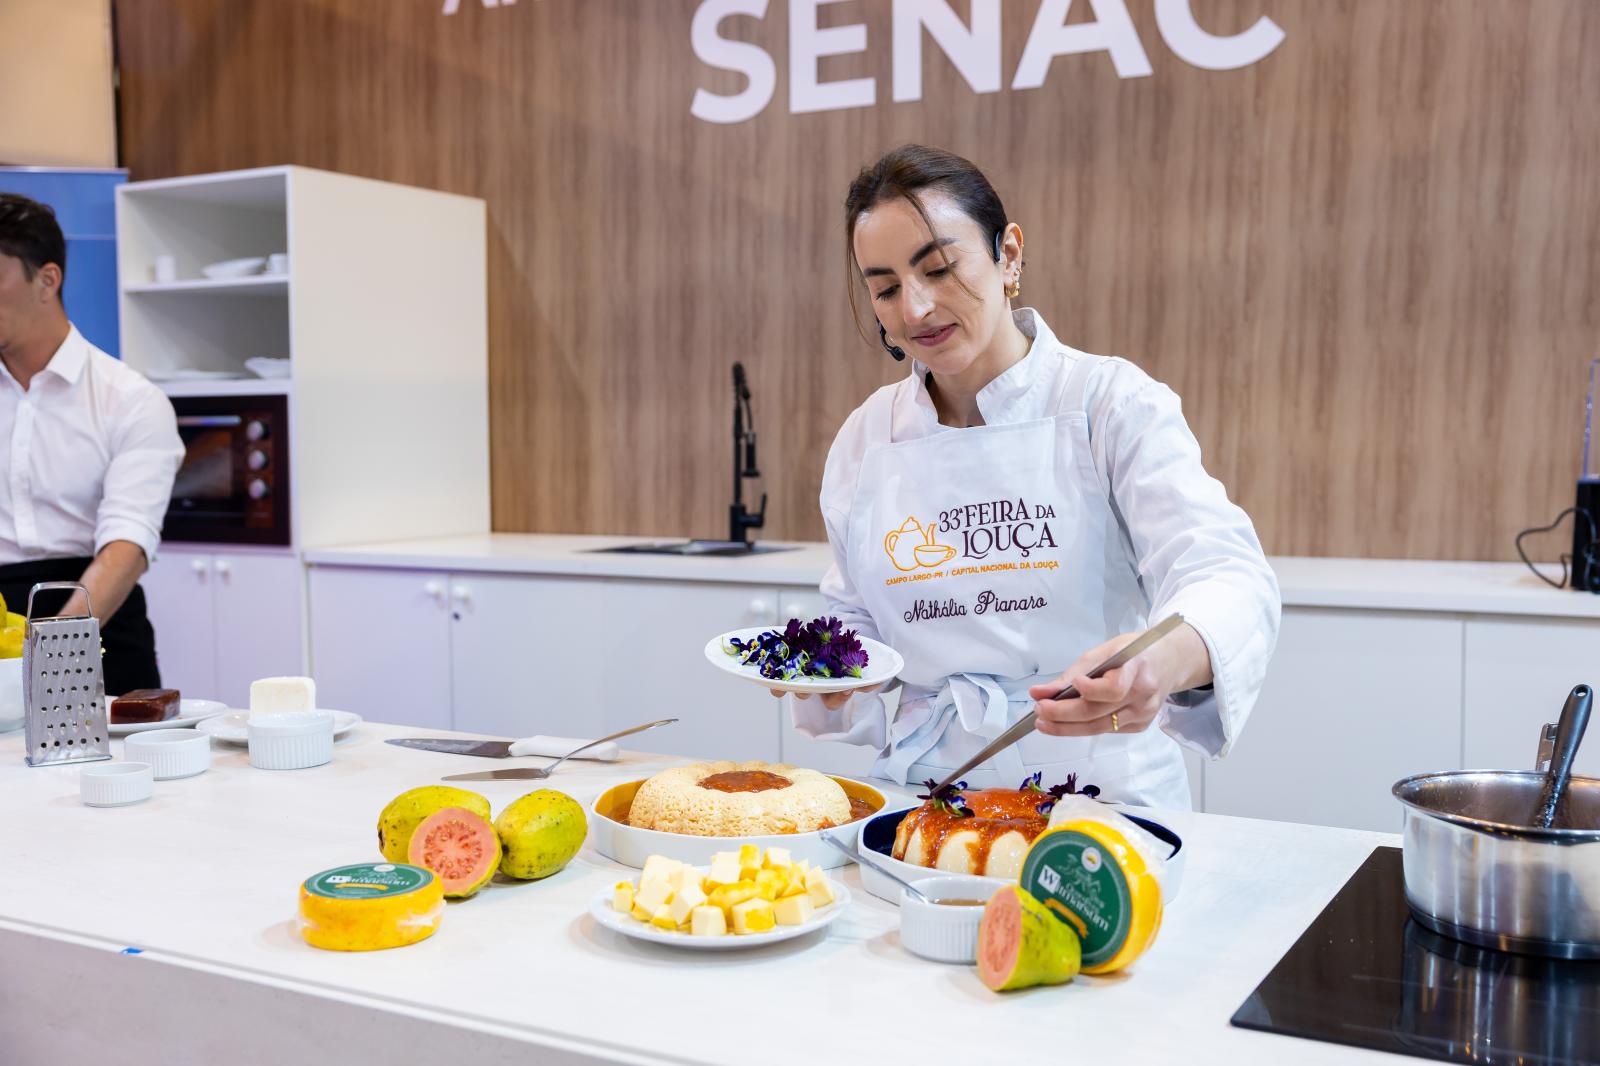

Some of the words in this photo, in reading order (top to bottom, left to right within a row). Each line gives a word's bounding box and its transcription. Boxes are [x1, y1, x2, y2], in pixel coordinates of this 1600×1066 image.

[1035, 504, 1056, 519] DA
[962, 521, 1058, 559] LOUÇA
[886, 575, 908, 586] CAMPO
[909, 571, 944, 582] LARGO-PR
[951, 567, 979, 577] CAPITAL
[980, 563, 1017, 573] NACIONAL
[1020, 562, 1031, 570] DA
[1033, 560, 1059, 571] LOUÇA
[904, 598, 967, 623] Nathália
[974, 590, 1048, 615] Pianaro
